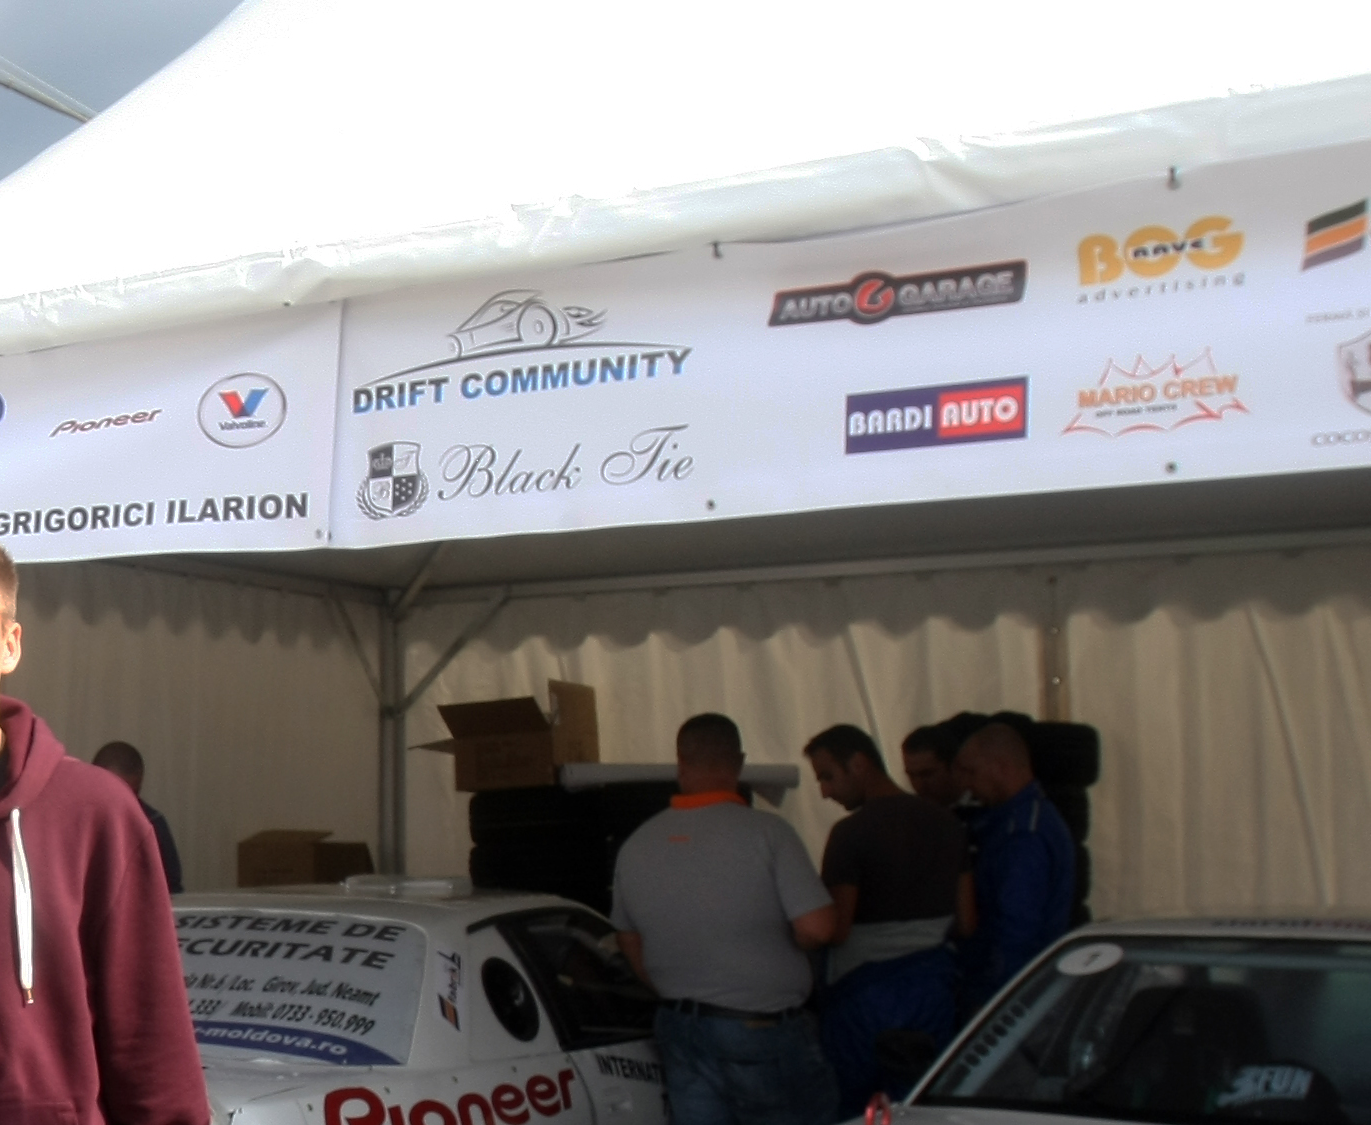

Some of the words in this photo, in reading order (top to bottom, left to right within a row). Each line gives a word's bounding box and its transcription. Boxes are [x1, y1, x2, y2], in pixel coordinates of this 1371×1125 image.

[780, 292, 853, 321] AUTO
[898, 270, 1015, 306] GARAGE
[1078, 272, 1245, 303] advertising
[352, 376, 450, 414] DRIFT
[461, 349, 692, 400] COMMUNITY
[1078, 383, 1157, 407] MARIO
[1163, 374, 1238, 400] CREW
[49, 408, 163, 437] Pioneer
[848, 404, 933, 436] BARDI
[941, 395, 1019, 428] AUTO
[438, 443, 582, 501] Black
[599, 424, 694, 486] Tie
[166, 492, 310, 525] ILARION
[175, 915, 338, 935] SISTEME
[342, 923, 407, 942] DE
